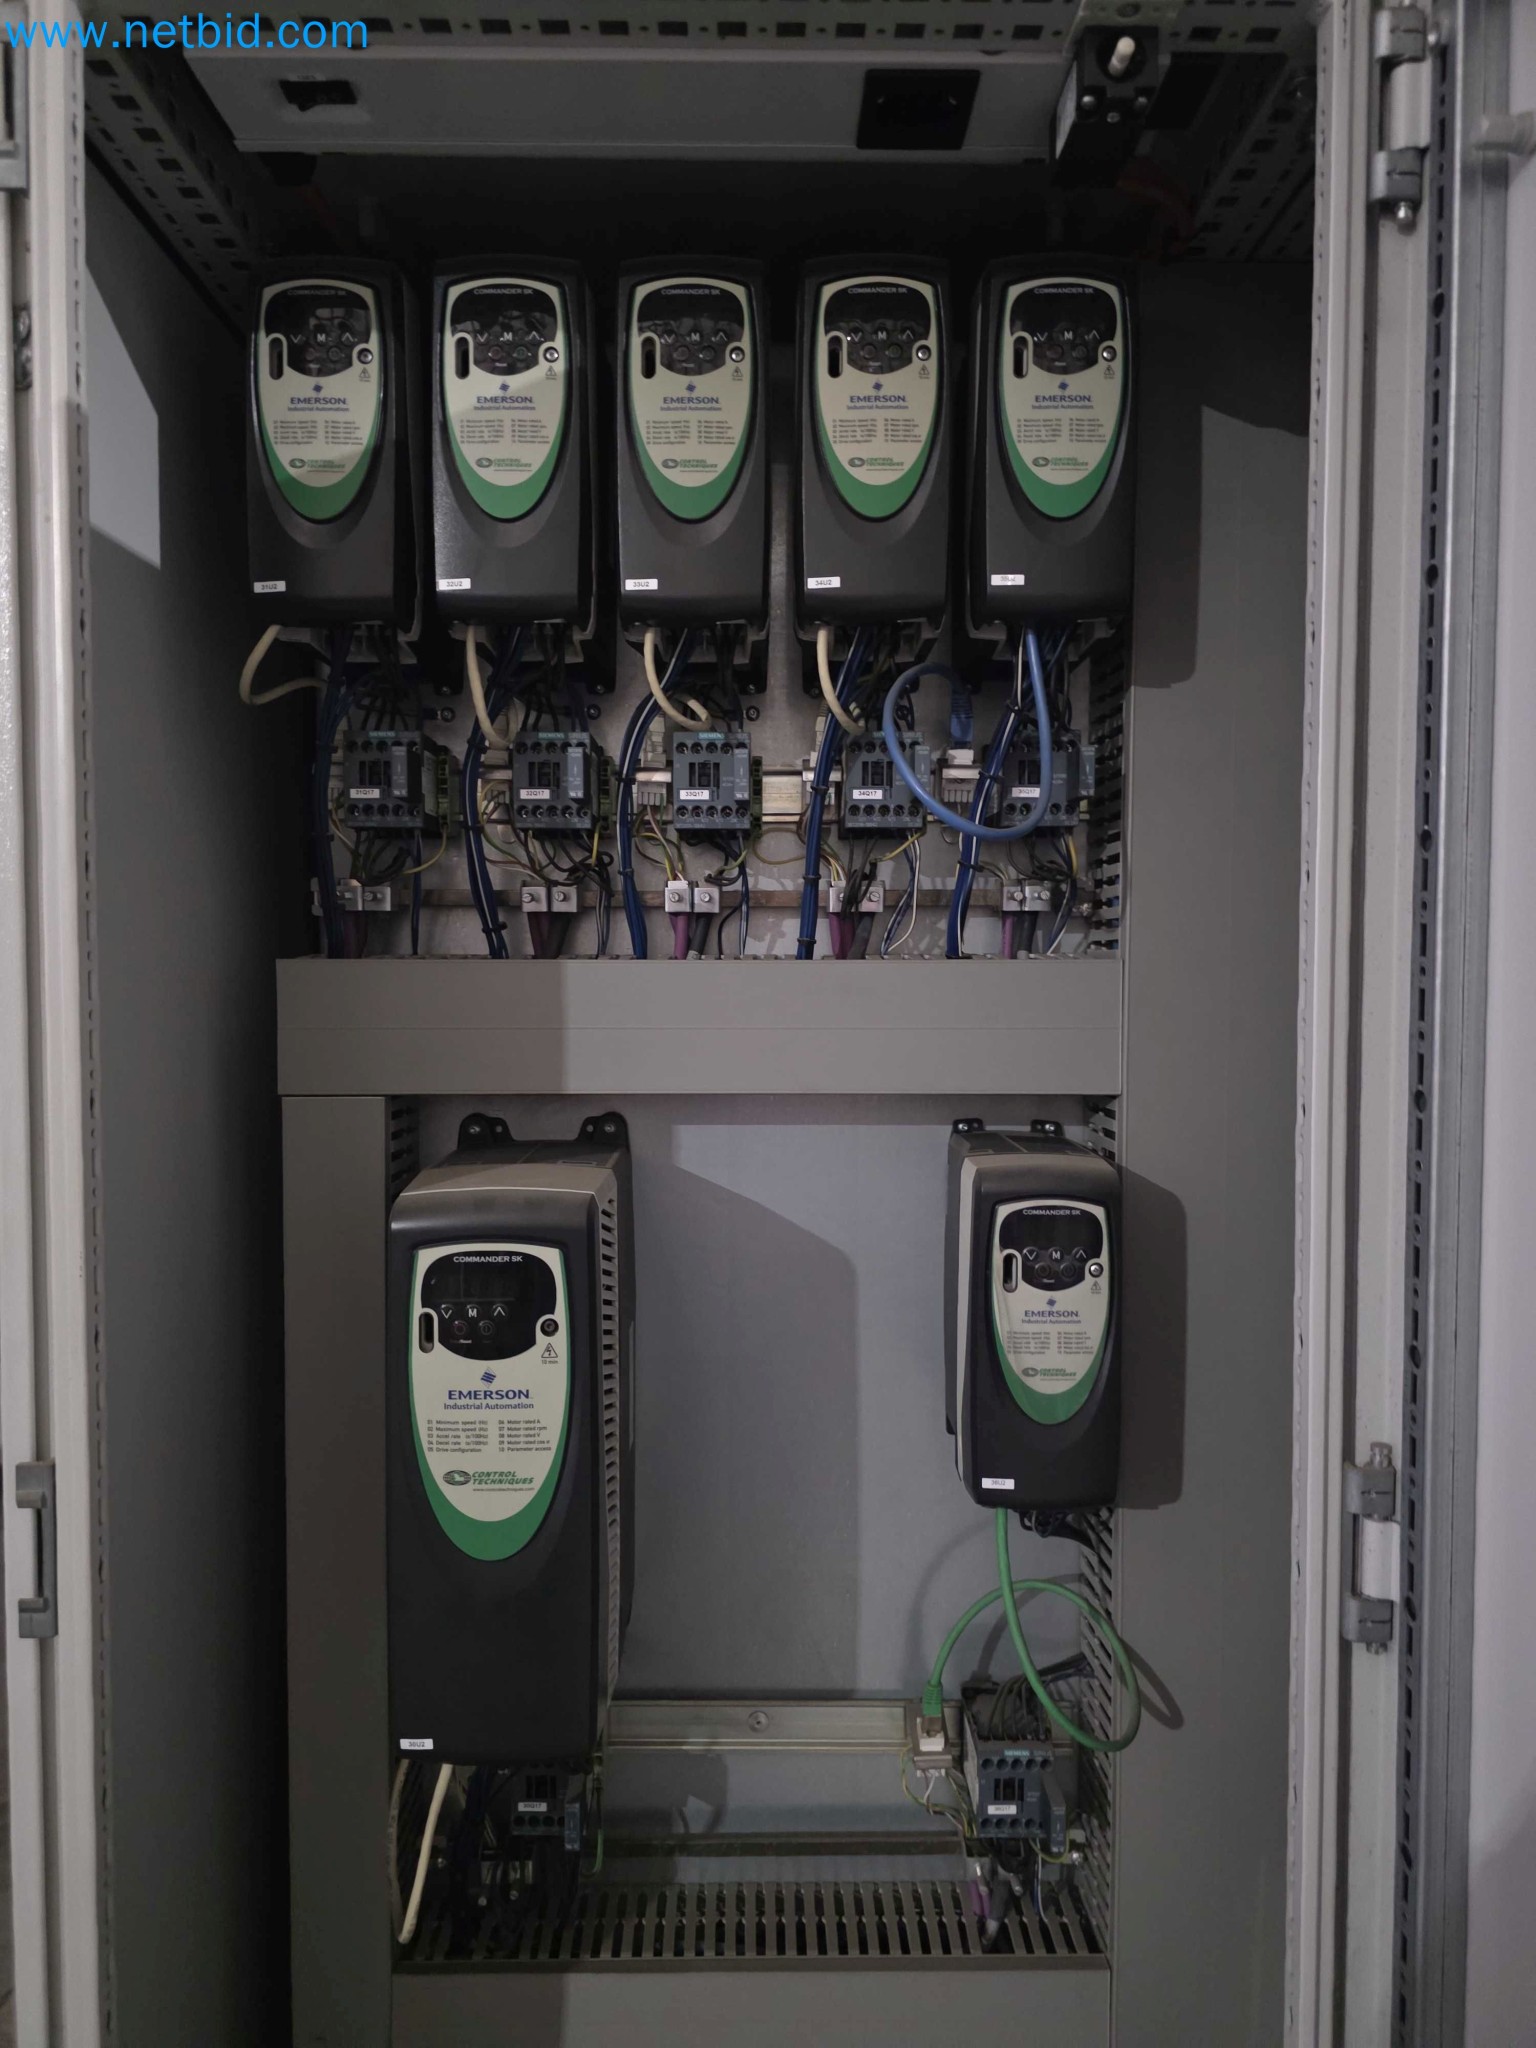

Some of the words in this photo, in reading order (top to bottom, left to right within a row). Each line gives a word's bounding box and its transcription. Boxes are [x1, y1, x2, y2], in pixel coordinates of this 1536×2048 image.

[316, 334, 326, 342] M
[503, 332, 513, 342] M
[691, 334, 700, 342] M
[878, 332, 887, 341] M
[1064, 331, 1073, 340] M
[290, 397, 347, 405] EMERSON
[477, 396, 534, 404] EMERSON
[663, 396, 719, 405] EMERSON
[850, 395, 906, 403] EMERSON
[1035, 395, 1092, 403] EMERSON
[453, 1255, 510, 1263] COMMANDER
[1052, 1251, 1061, 1260] M
[468, 1308, 477, 1318] M
[1024, 1310, 1079, 1318] EMERSON
[448, 1389, 530, 1400] EMERSON
[484, 1402, 534, 1410] Automation
[472, 1477, 534, 1485] TECHNIQUES
